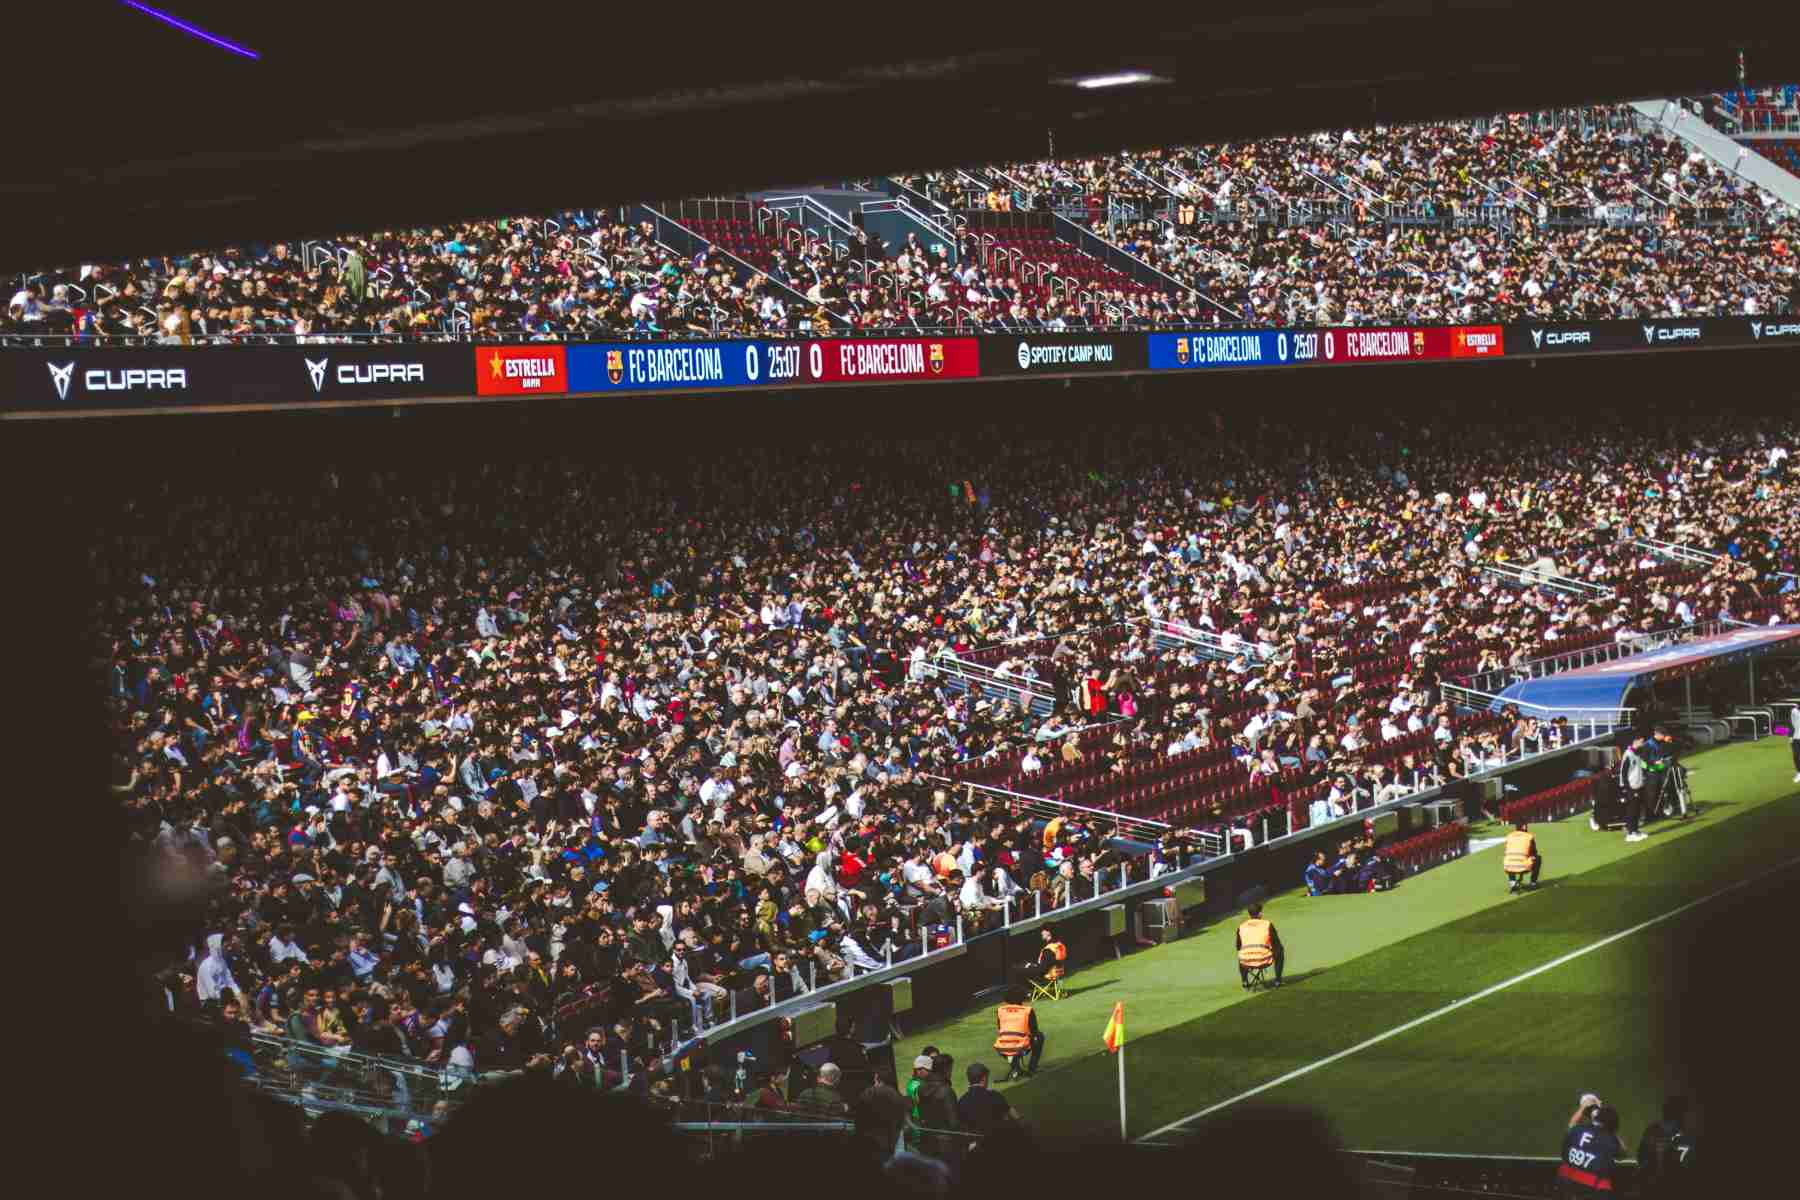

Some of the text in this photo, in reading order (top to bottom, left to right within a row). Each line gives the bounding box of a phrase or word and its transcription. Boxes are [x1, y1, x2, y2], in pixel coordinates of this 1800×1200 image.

[1546, 331, 1591, 345] CUPRA
[1658, 328, 1701, 340] CUPRA
[1766, 324, 1800, 336] CUPR
[1031, 344, 1113, 363] SPOTIFY CAMP NOU
[1193, 332, 1410, 362] FC BARCELONA 0 25:07 0 FC BARCELONA
[505, 358, 555, 377] ESTRELLA
[629, 344, 925, 382] FC BARCELONA 0 25:07 0 FC BARCELONA
[86, 369, 187, 391] CUPRA
[338, 364, 425, 384] CUPRA
[1579, 1132, 1594, 1147] F
[1568, 1148, 1596, 1168] 697
